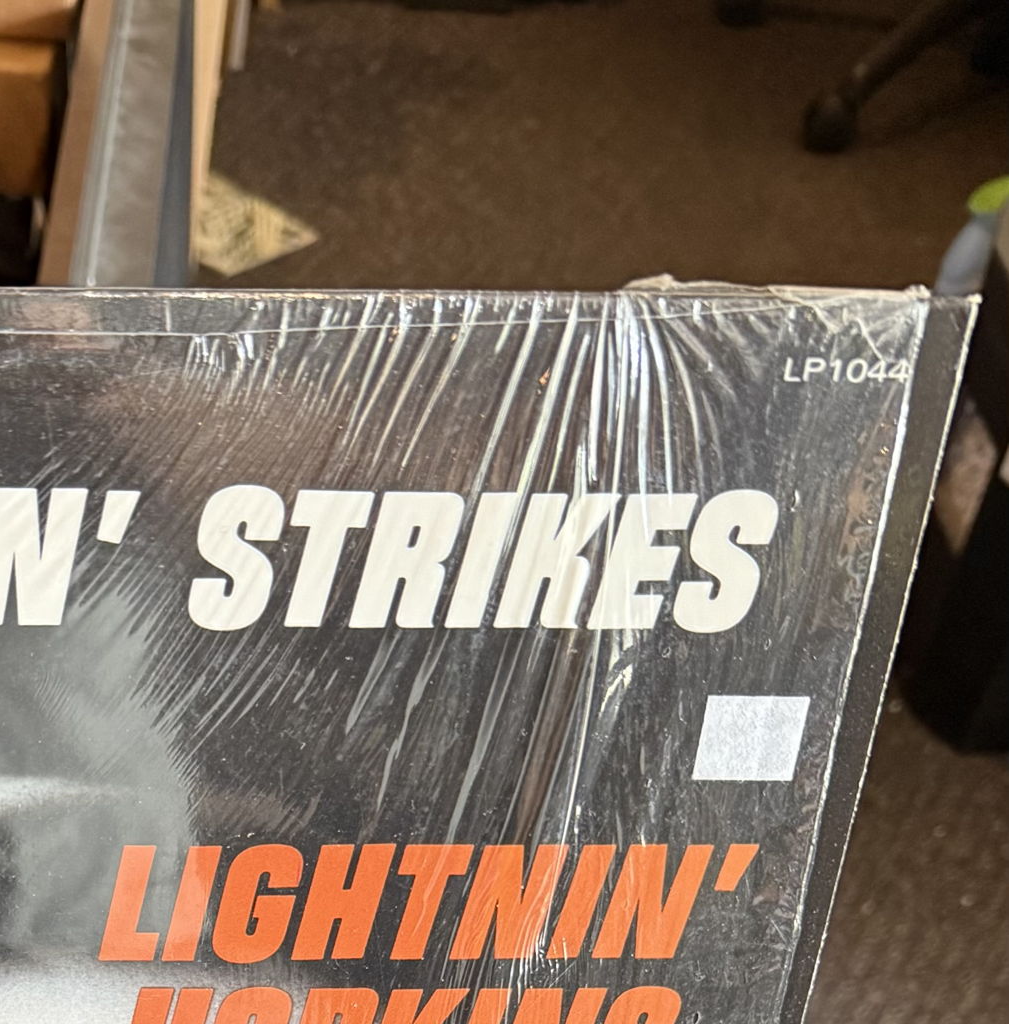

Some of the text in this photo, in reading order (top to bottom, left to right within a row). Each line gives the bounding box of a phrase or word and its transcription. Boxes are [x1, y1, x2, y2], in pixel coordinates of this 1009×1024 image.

[783, 357, 912, 383] LP1044
[188, 484, 779, 634] STRIKES
[97, 843, 760, 964] LIGHTNIN'
